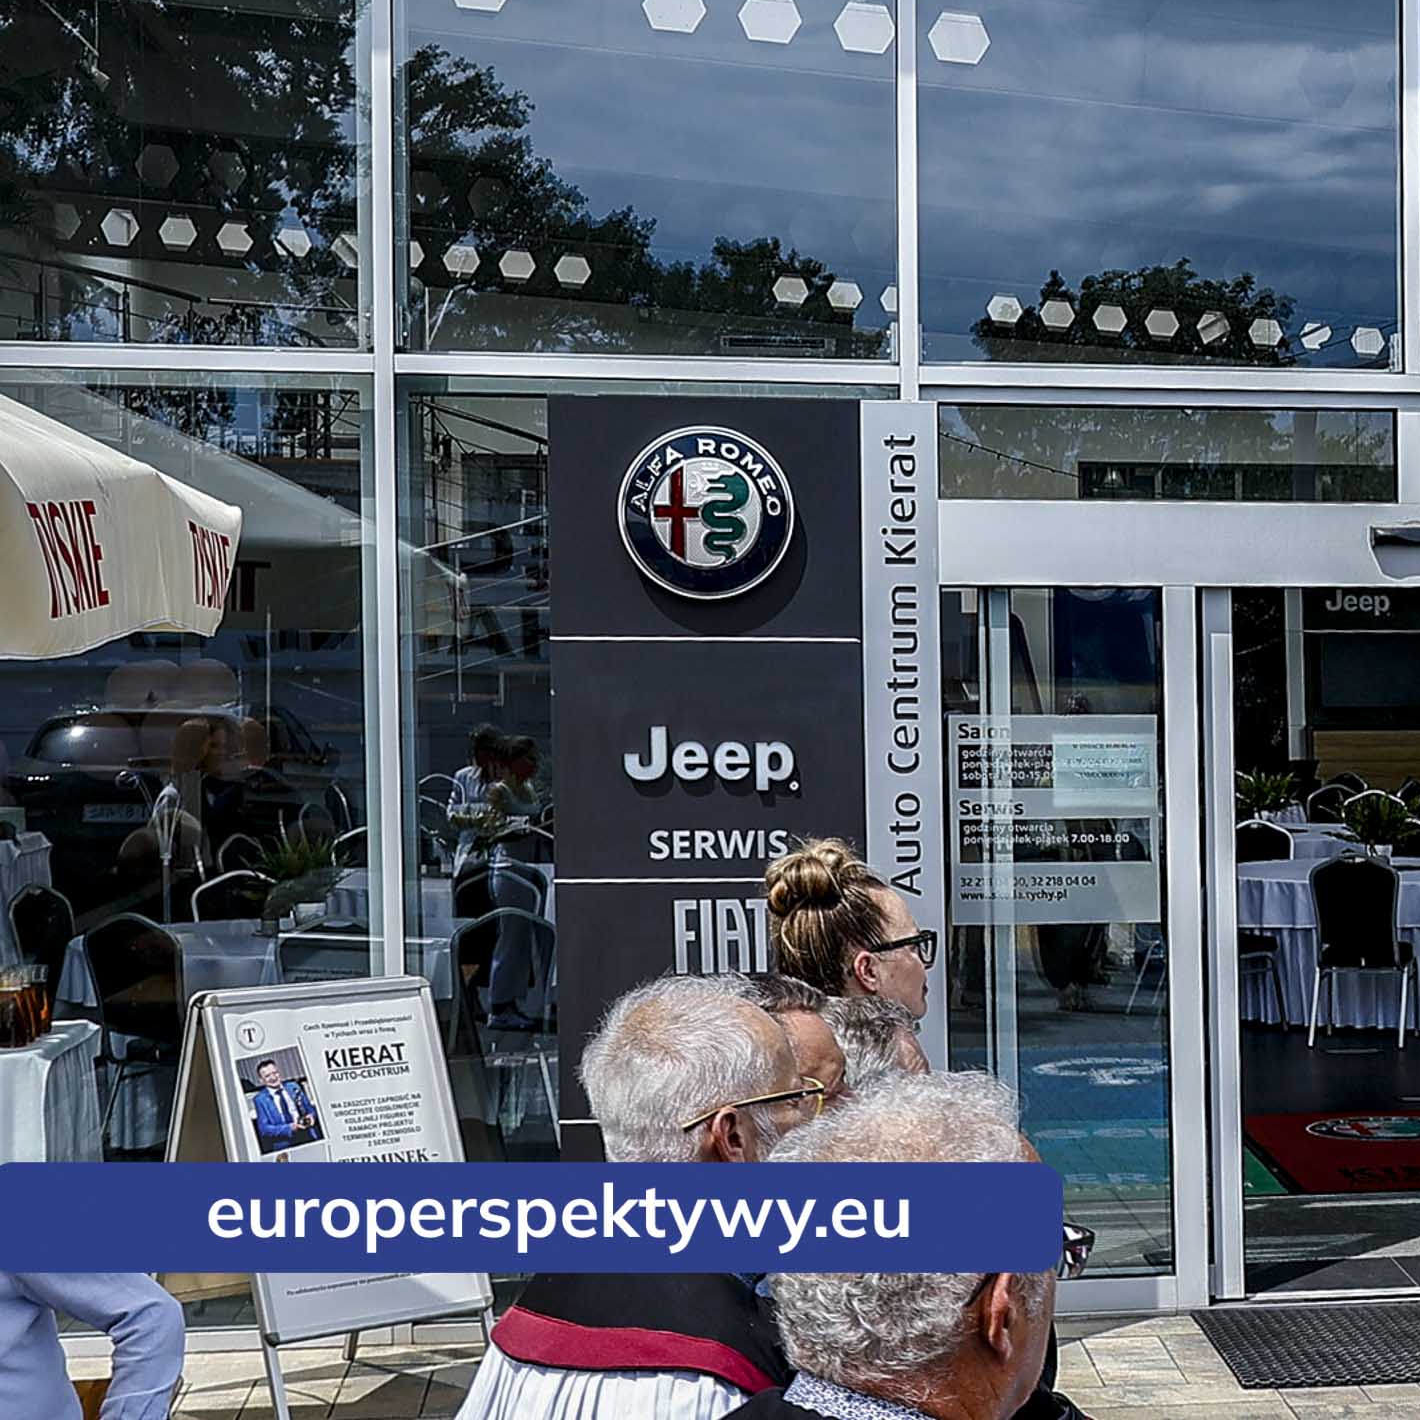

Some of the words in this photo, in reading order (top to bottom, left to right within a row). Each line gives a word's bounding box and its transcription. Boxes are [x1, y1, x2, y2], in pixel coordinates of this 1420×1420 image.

[630, 445, 685, 514] ALFA
[697, 436, 782, 517] ROMEO
[880, 433, 918, 566] Kierat
[26, 500, 110, 619] TYSKIE
[1325, 589, 1391, 616] Jeep
[886, 585, 920, 775] Centrum
[623, 725, 799, 791] Jeep
[649, 829, 789, 861] SERWIS
[889, 793, 922, 897] Auto
[672, 898, 769, 975] FIAT
[324, 1042, 406, 1068] KIERAT
[329, 1065, 410, 1082] AUTO-CENTRUM
